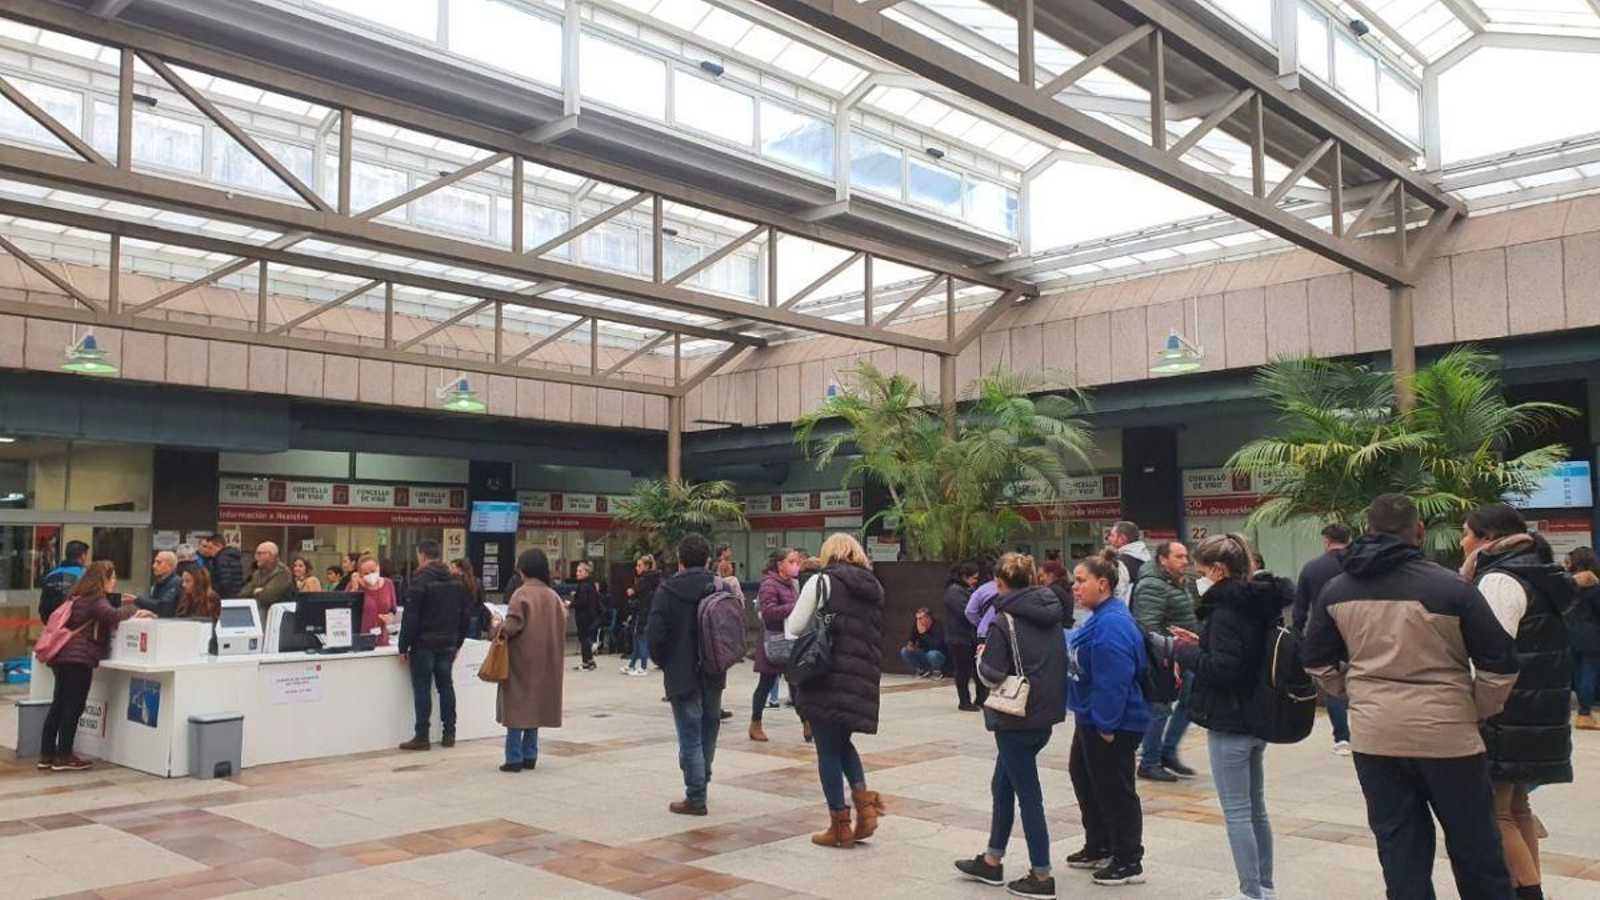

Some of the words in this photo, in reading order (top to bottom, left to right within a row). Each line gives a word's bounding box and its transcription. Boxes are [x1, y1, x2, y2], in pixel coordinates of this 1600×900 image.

[1189, 474, 1227, 482] CONCELLO
[225, 483, 264, 491] CONCELLO
[293, 486, 329, 494] CONCELLO
[219, 510, 268, 520] Información
[1185, 508, 1208, 516] Tasas
[1210, 505, 1252, 514] Ocupación
[391, 515, 430, 524] Información
[225, 532, 240, 544] 14
[1192, 527, 1208, 539] 22
[448, 535, 461, 546] 15
[547, 535, 559, 547] 16
